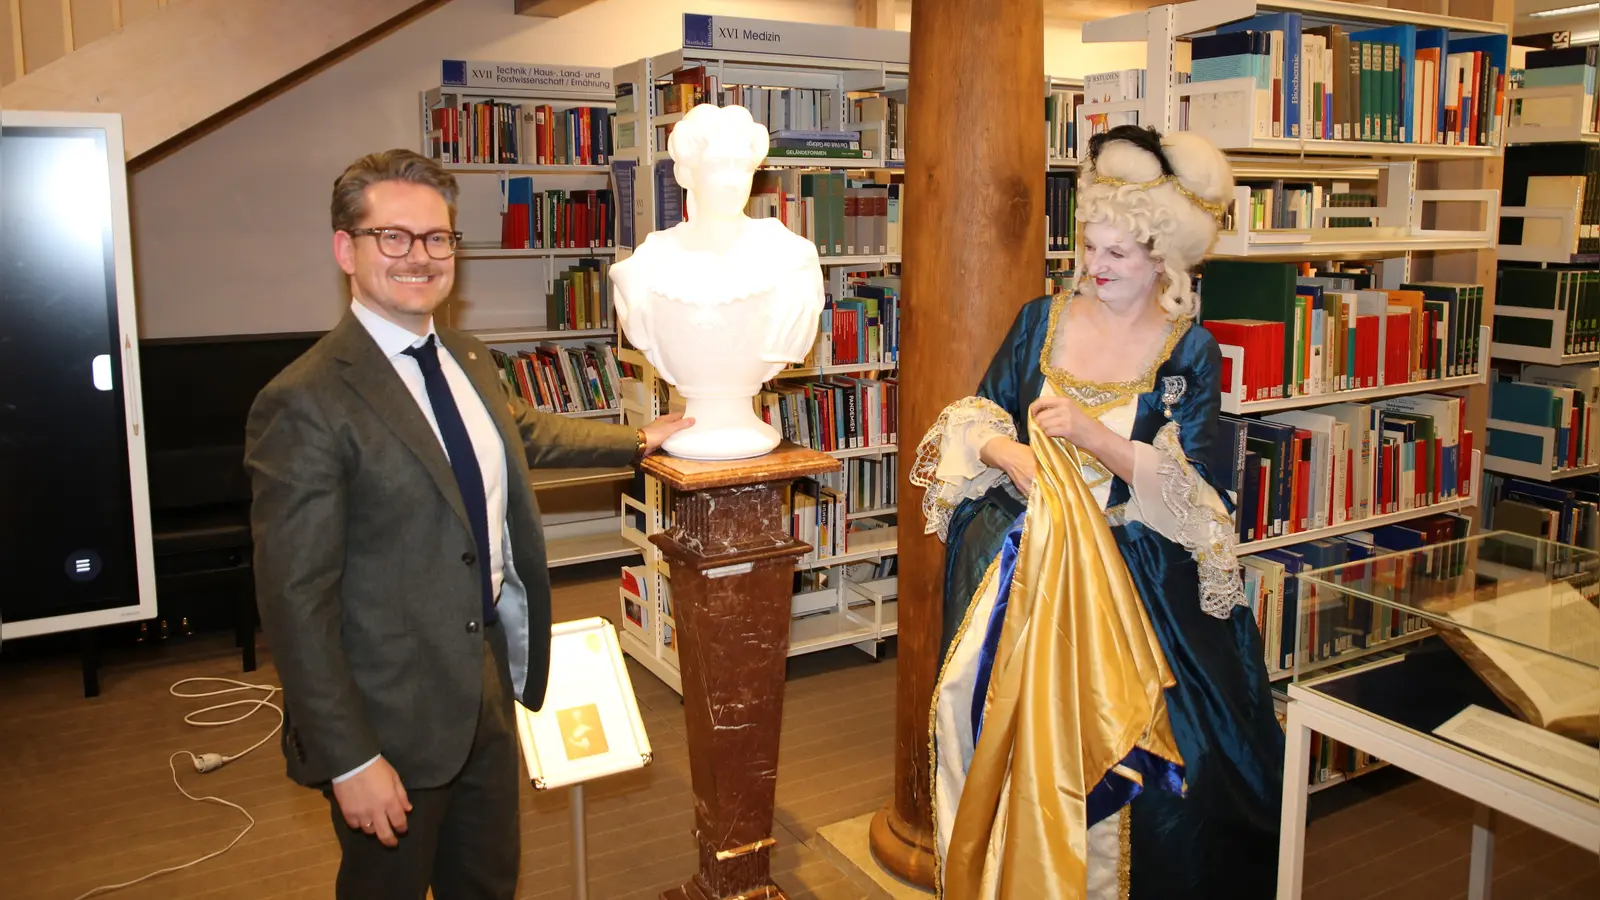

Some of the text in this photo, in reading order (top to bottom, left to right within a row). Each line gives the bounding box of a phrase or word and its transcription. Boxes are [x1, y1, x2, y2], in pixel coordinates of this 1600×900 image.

[718, 27, 781, 42] XVI Medizin
[471, 69, 492, 79] XVII
[496, 65, 527, 76] Technik
[533, 67, 559, 77] Haus-,
[560, 69, 583, 78] Land-
[585, 71, 600, 79] und
[496, 75, 564, 86] Forstwissenschaft
[571, 78, 610, 89] Ernährung
